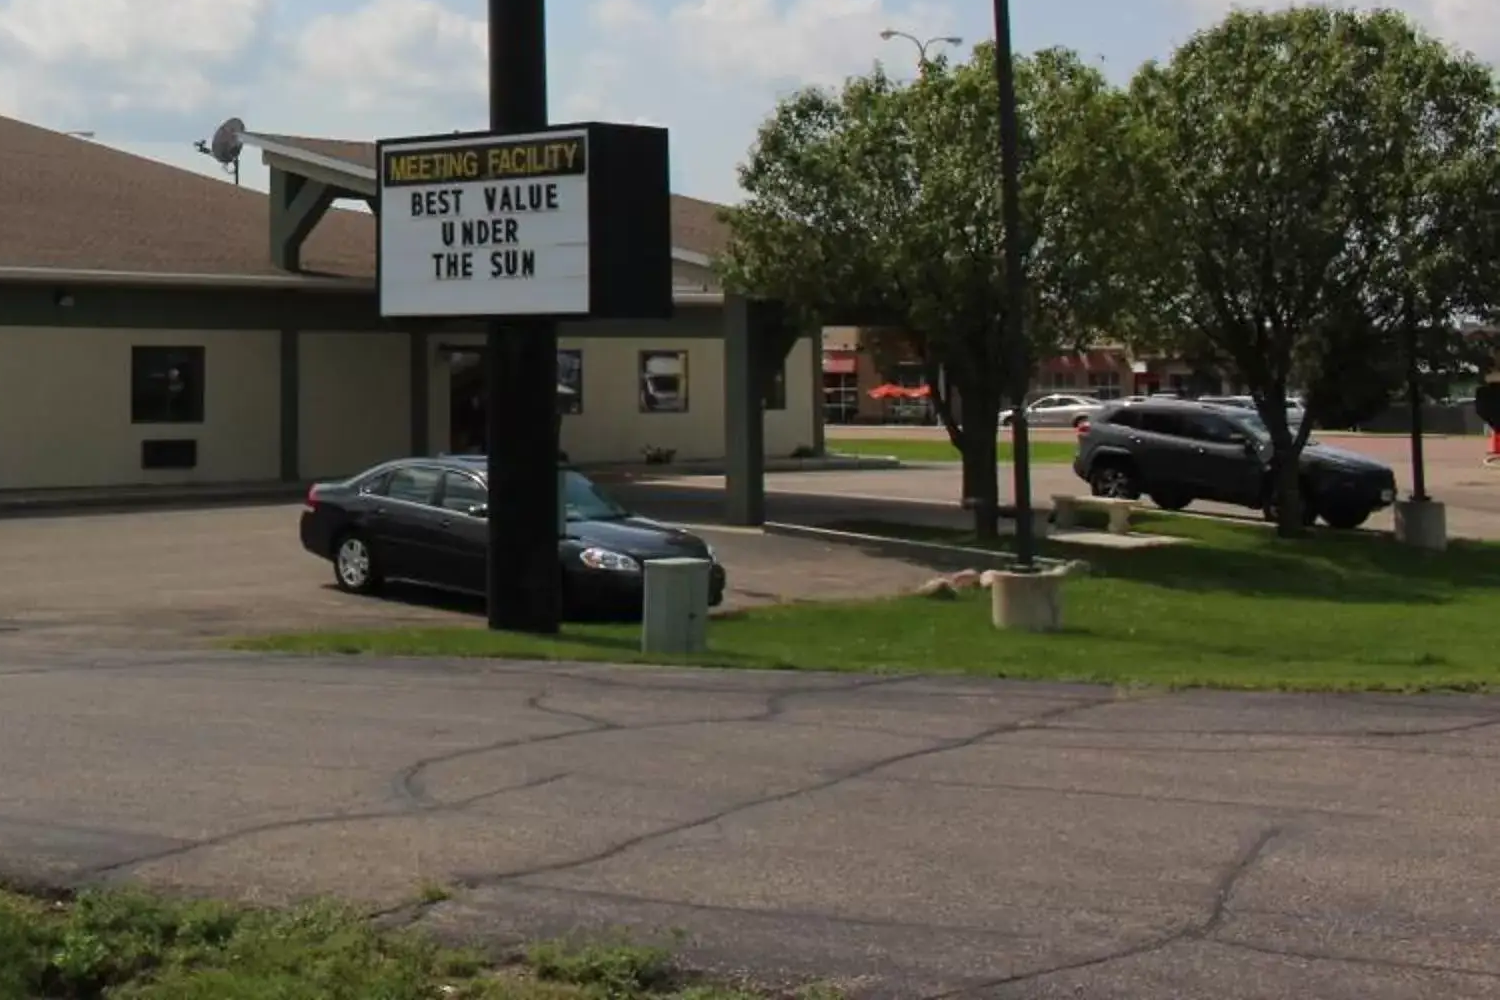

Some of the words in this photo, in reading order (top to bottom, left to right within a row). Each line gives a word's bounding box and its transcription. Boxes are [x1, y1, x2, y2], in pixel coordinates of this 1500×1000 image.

[390, 152, 479, 181] MEETING
[488, 143, 578, 174] FACILITY
[411, 189, 463, 216] BEST
[484, 183, 559, 211] VALUE
[441, 218, 518, 246] UNDER
[432, 252, 473, 278] THE
[490, 250, 536, 278] SUN
